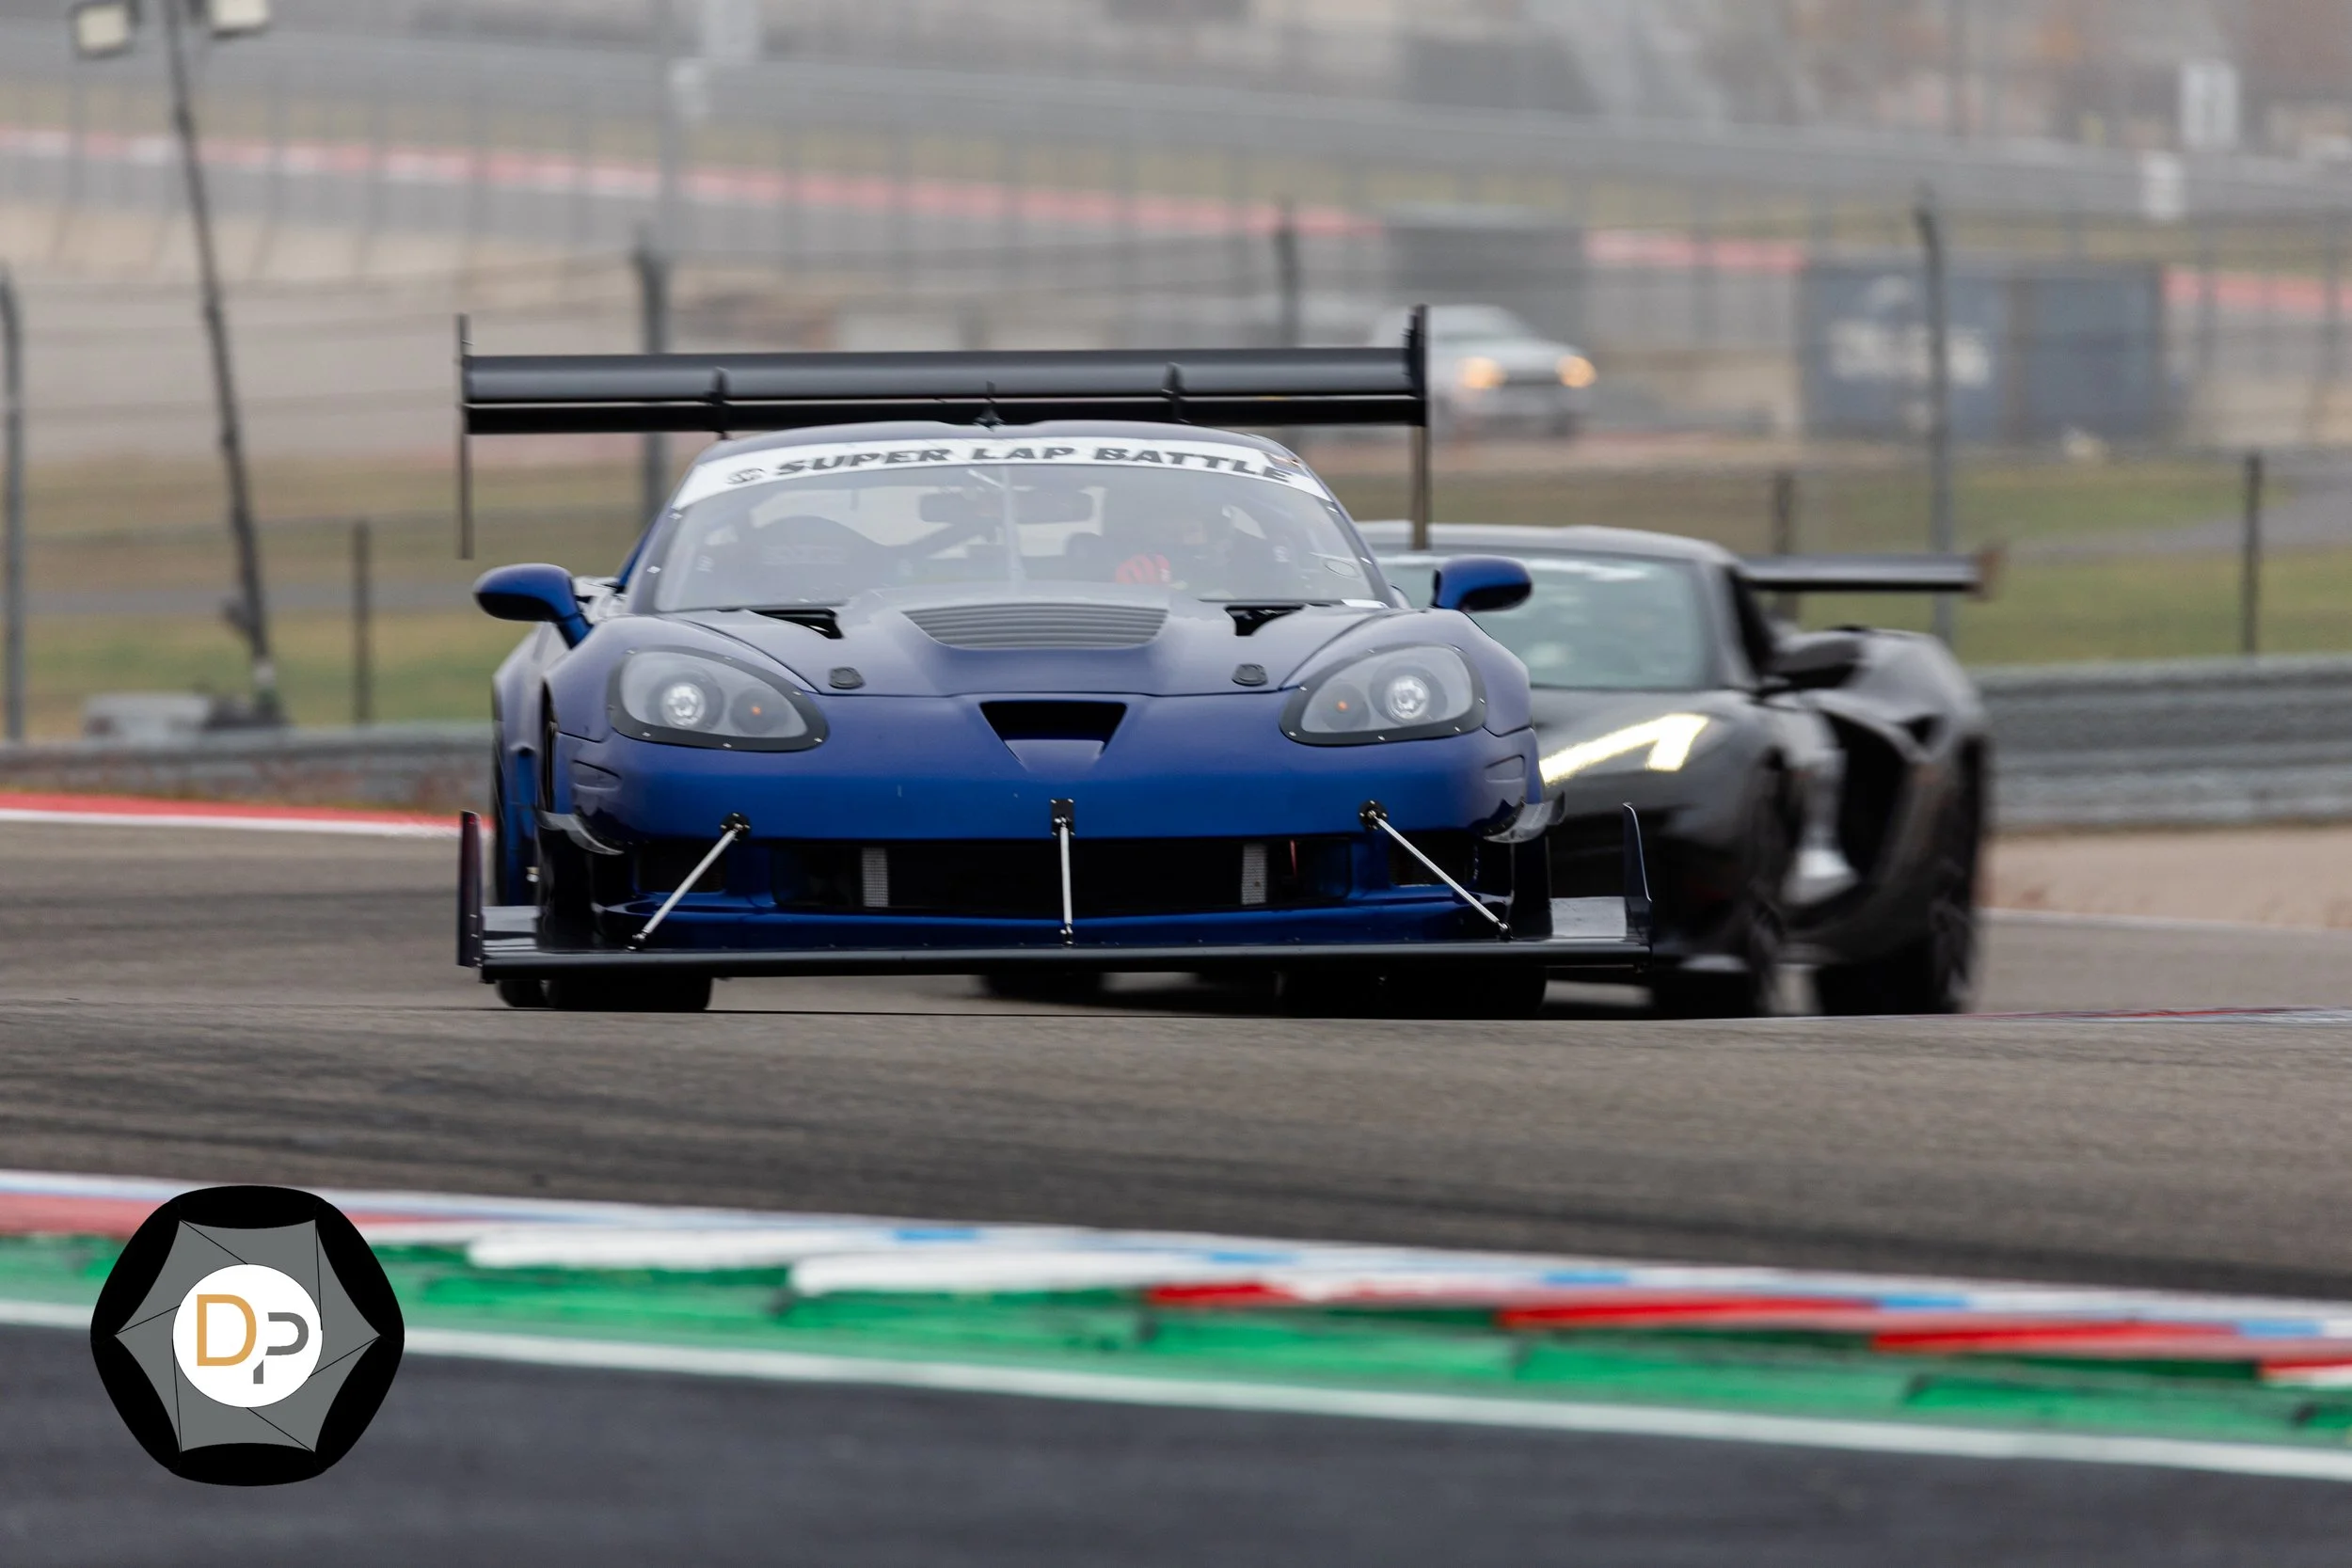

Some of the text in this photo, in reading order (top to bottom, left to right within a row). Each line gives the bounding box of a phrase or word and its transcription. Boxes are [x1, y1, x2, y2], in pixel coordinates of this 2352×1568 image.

[776, 447, 1293, 483] SUPER LAP BATTLE
